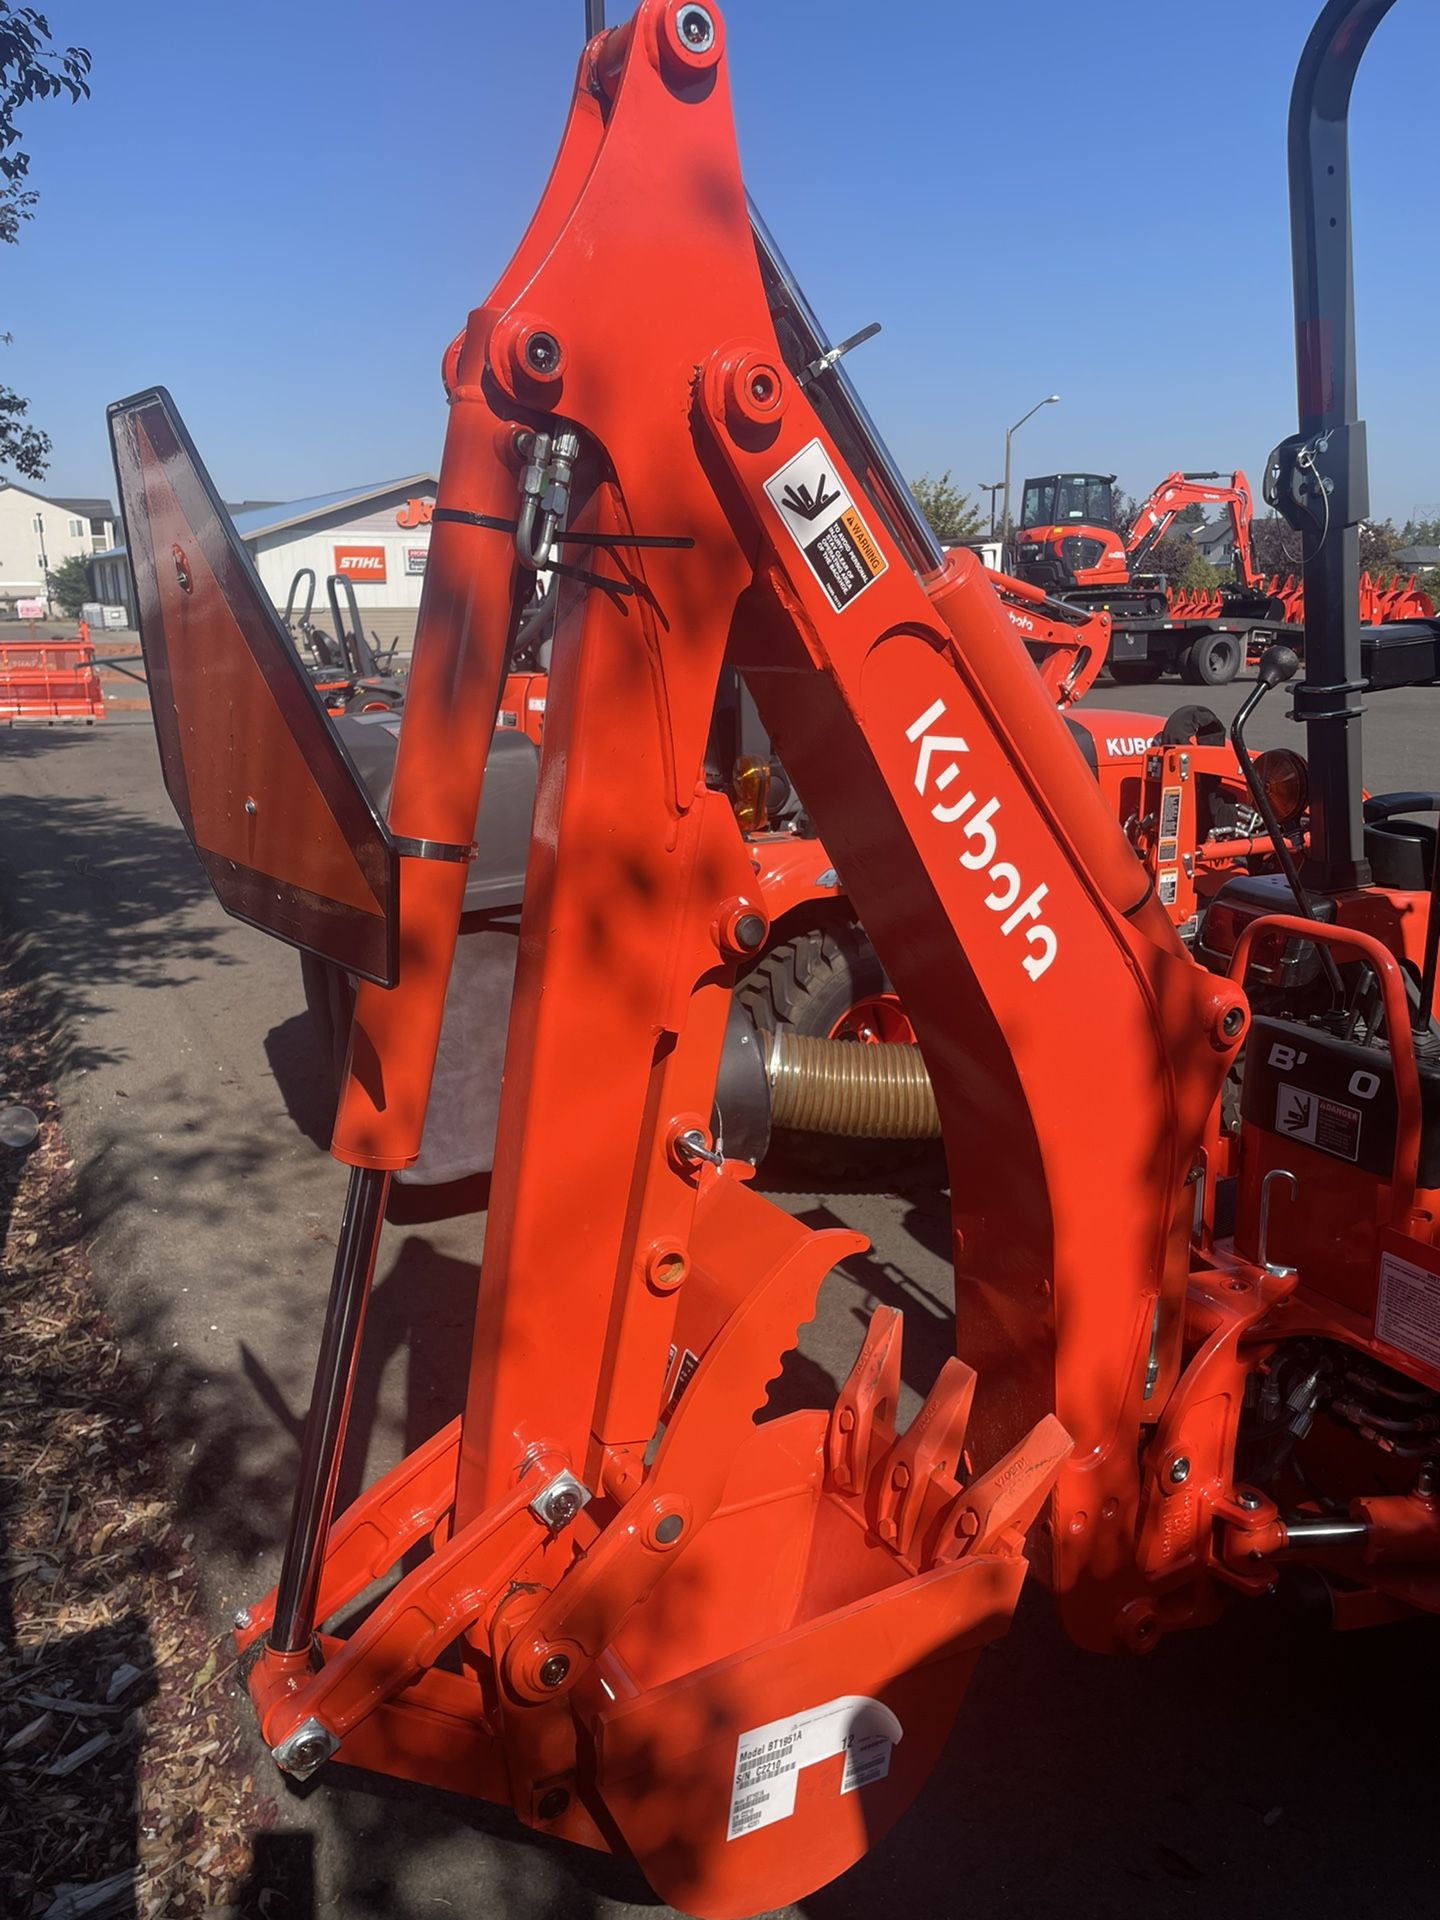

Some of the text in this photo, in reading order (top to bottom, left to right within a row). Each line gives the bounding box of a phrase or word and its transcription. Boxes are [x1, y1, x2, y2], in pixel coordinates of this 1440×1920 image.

[816, 541, 824, 552] OF
[822, 551, 832, 565] THE
[825, 533, 854, 580] STAY CLEAR OF
[832, 522, 869, 583] TO AVOID PERSONAL
[850, 525, 880, 569] WARNING
[339, 557, 384, 568] STIHL
[820, 537, 843, 573] OPERATING
[840, 571, 852, 589] AREA
[1007, 611, 1034, 631] bota
[1106, 737, 1153, 756] KUB
[905, 698, 1057, 982] Kubota
[739, 1730, 803, 1763] Model BT1951A
[841, 1734, 854, 1750] 12
[736, 1759, 781, 1785] S/N C2210
